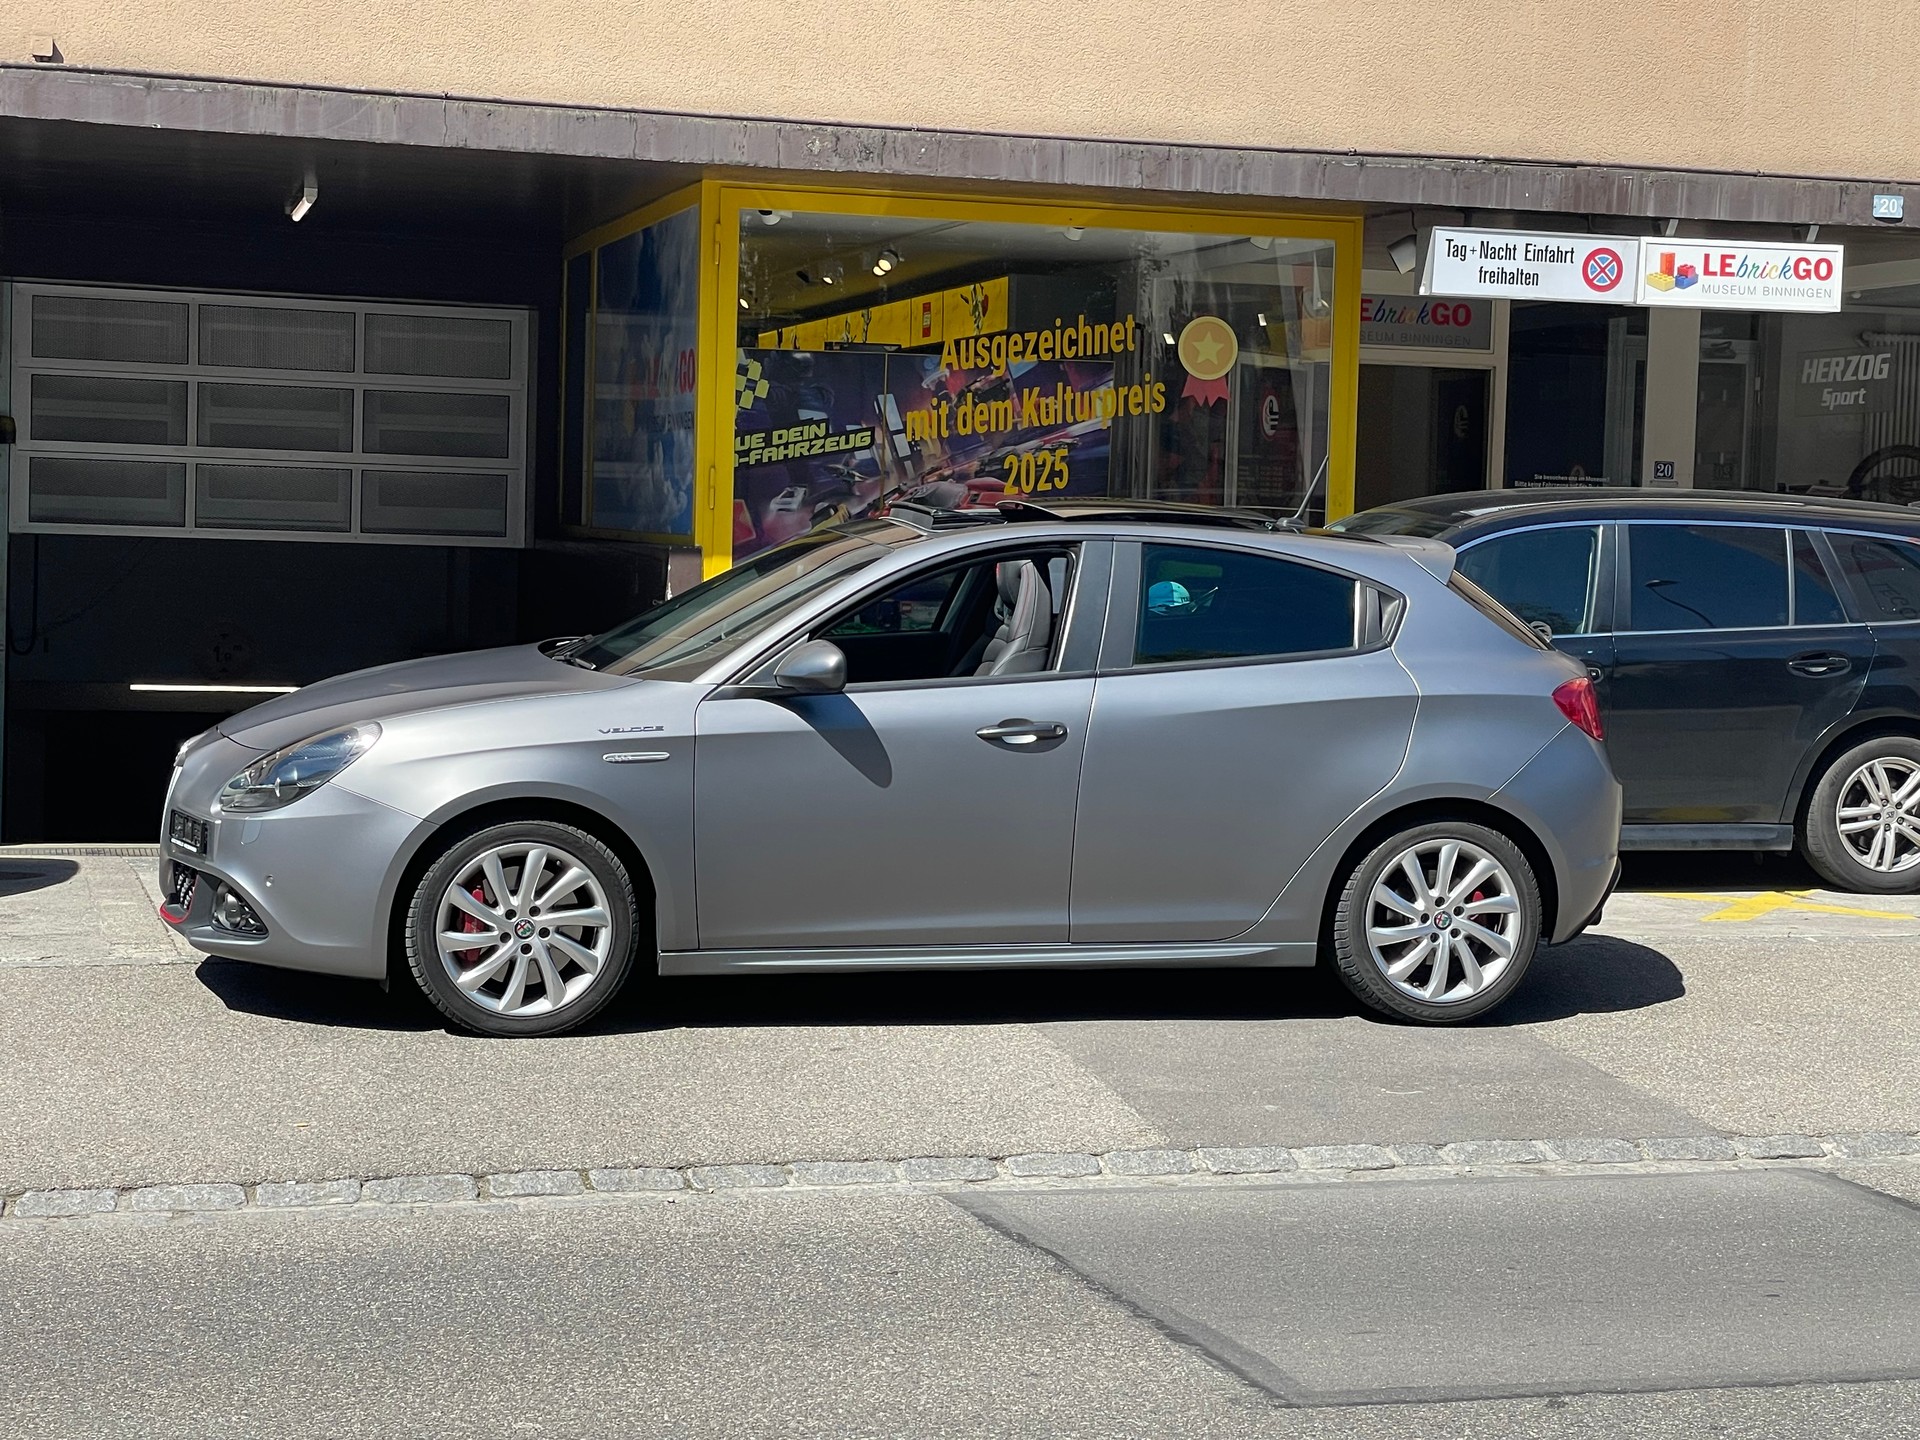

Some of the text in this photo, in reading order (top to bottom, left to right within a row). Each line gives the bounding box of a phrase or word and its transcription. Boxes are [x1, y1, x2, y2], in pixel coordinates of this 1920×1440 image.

[1879, 198, 1898, 214] 20
[1445, 238, 1467, 262] Tag
[1479, 240, 1516, 261] Nacht
[1524, 243, 1574, 264] Einfahrt
[1478, 266, 1539, 286] freihalten
[1702, 253, 1833, 281] LEbrickGO
[1701, 283, 1832, 299] MUSEUM BINNINGEN
[1360, 298, 1472, 328] EbrickGO
[940, 314, 1135, 377] Ausgezeichnet
[1360, 330, 1472, 346] SEUM BINNINGEN
[1801, 353, 1891, 384] HERZOG
[906, 373, 1167, 441] mit dem Kulturpreis
[1821, 388, 1866, 410] Sport
[735, 422, 826, 451] UE DEIN
[735, 431, 872, 467] -FAHRZEUG
[1003, 449, 1070, 495] 2025
[1656, 463, 1672, 477] 20
[598, 725, 665, 735] VELOCE
